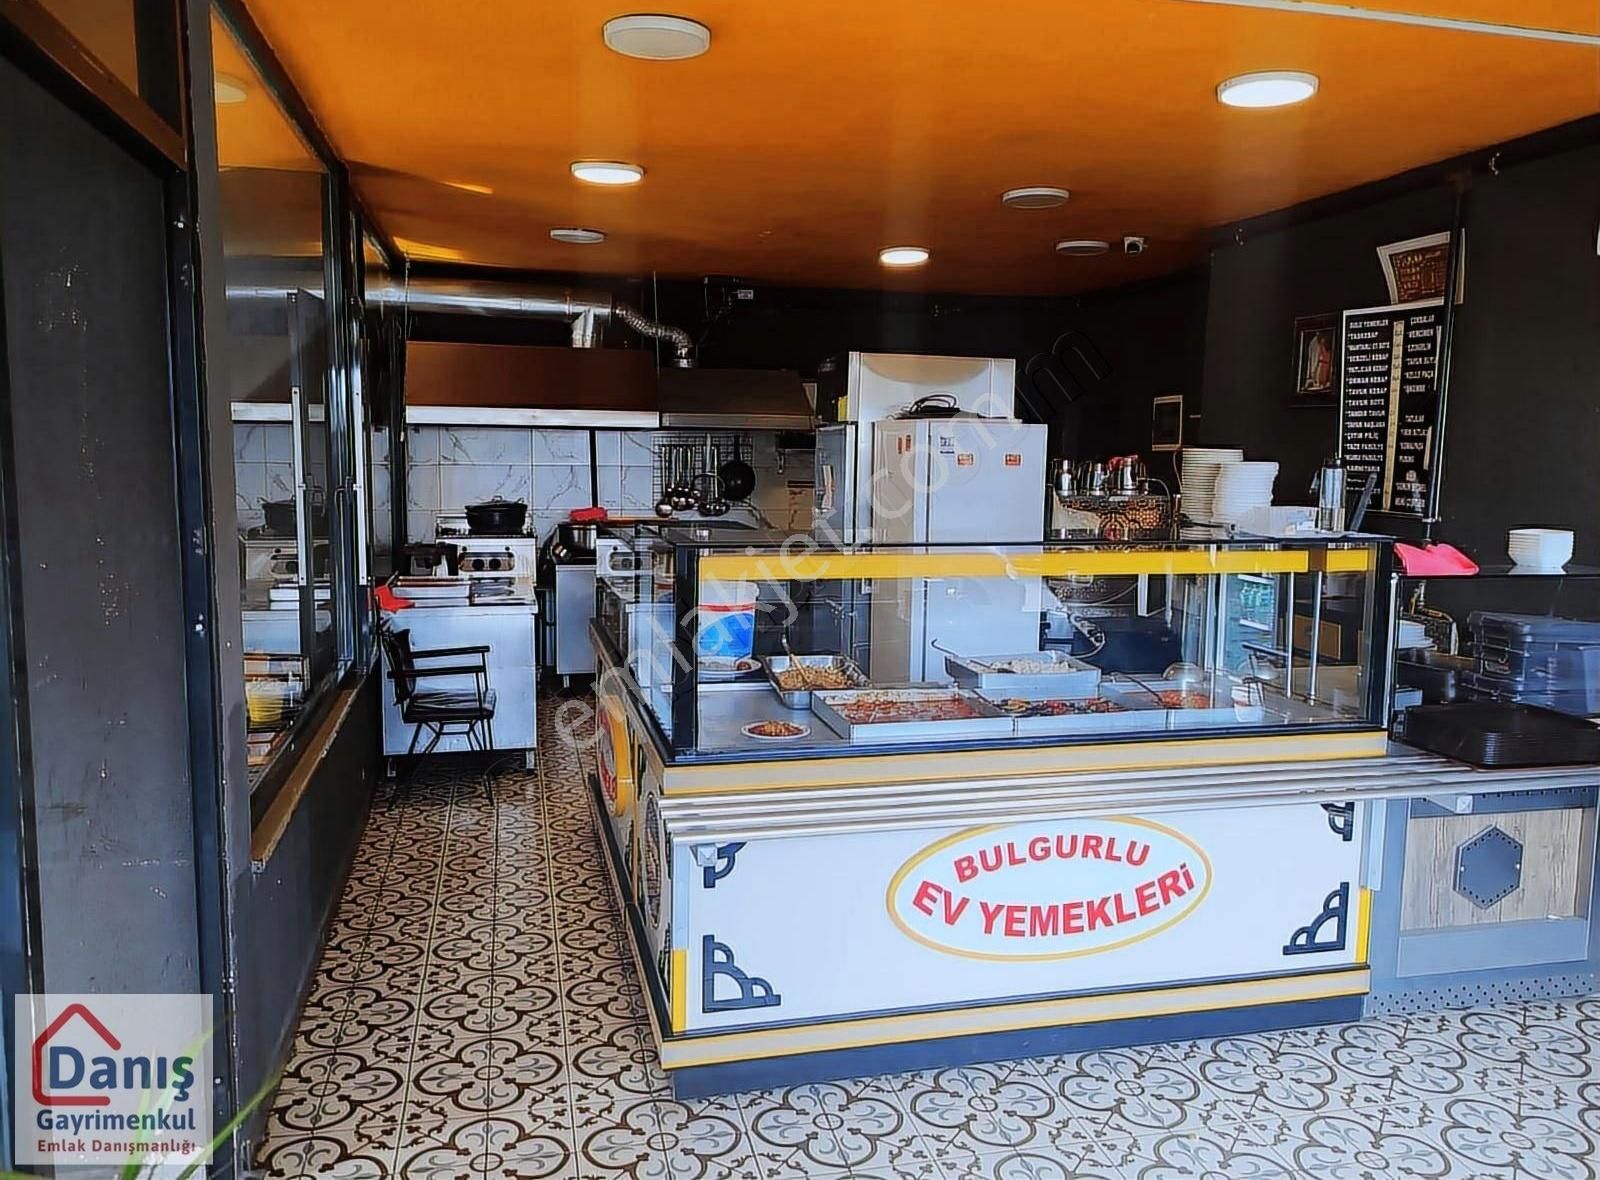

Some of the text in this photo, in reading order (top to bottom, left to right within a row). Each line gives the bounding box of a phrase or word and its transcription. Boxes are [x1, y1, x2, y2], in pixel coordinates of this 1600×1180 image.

[953, 834, 1151, 884] BULGURLU
[912, 863, 1196, 938] EV YEMEKLERİ
